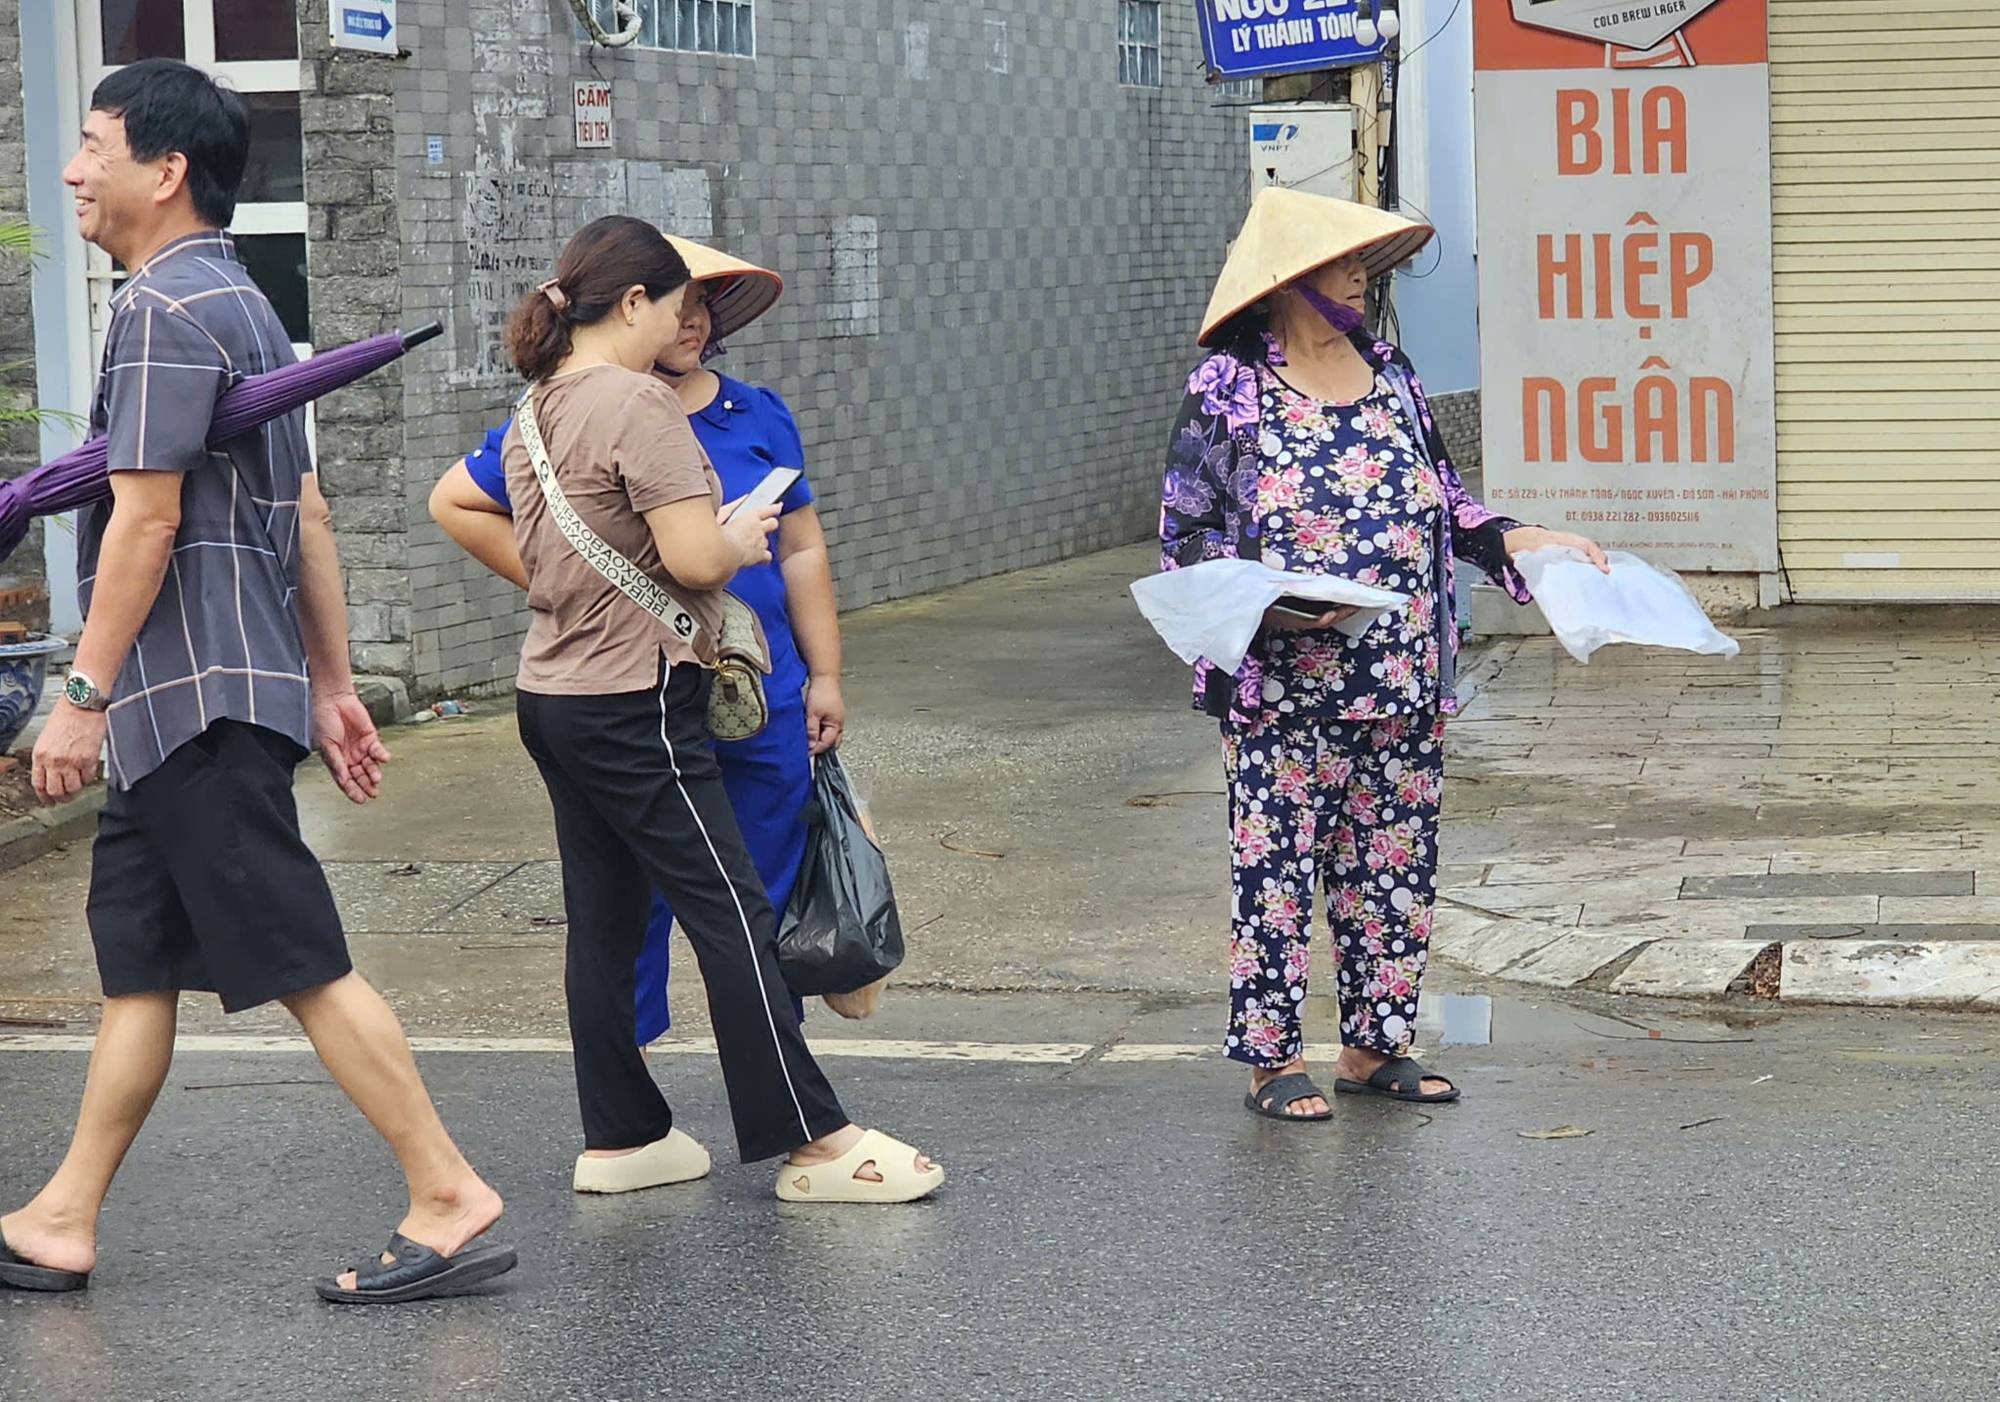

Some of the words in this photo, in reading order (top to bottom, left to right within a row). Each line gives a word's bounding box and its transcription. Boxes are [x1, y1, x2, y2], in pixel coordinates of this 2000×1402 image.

[1593, 13, 1619, 29] COLD
[1622, 8, 1651, 23] BREW
[1654, 1, 1687, 17] LAGER
[1231, 24, 1252, 53] LÝ
[1254, 18, 1315, 49] THÁNH
[1556, 85, 1687, 175] BIA
[1537, 211, 1713, 339] HIỆP
[1522, 355, 1735, 463] NGÂN
[1521, 488, 1538, 499] 229
[1580, 511, 1604, 522] 0938
[1623, 511, 1640, 522] 282
